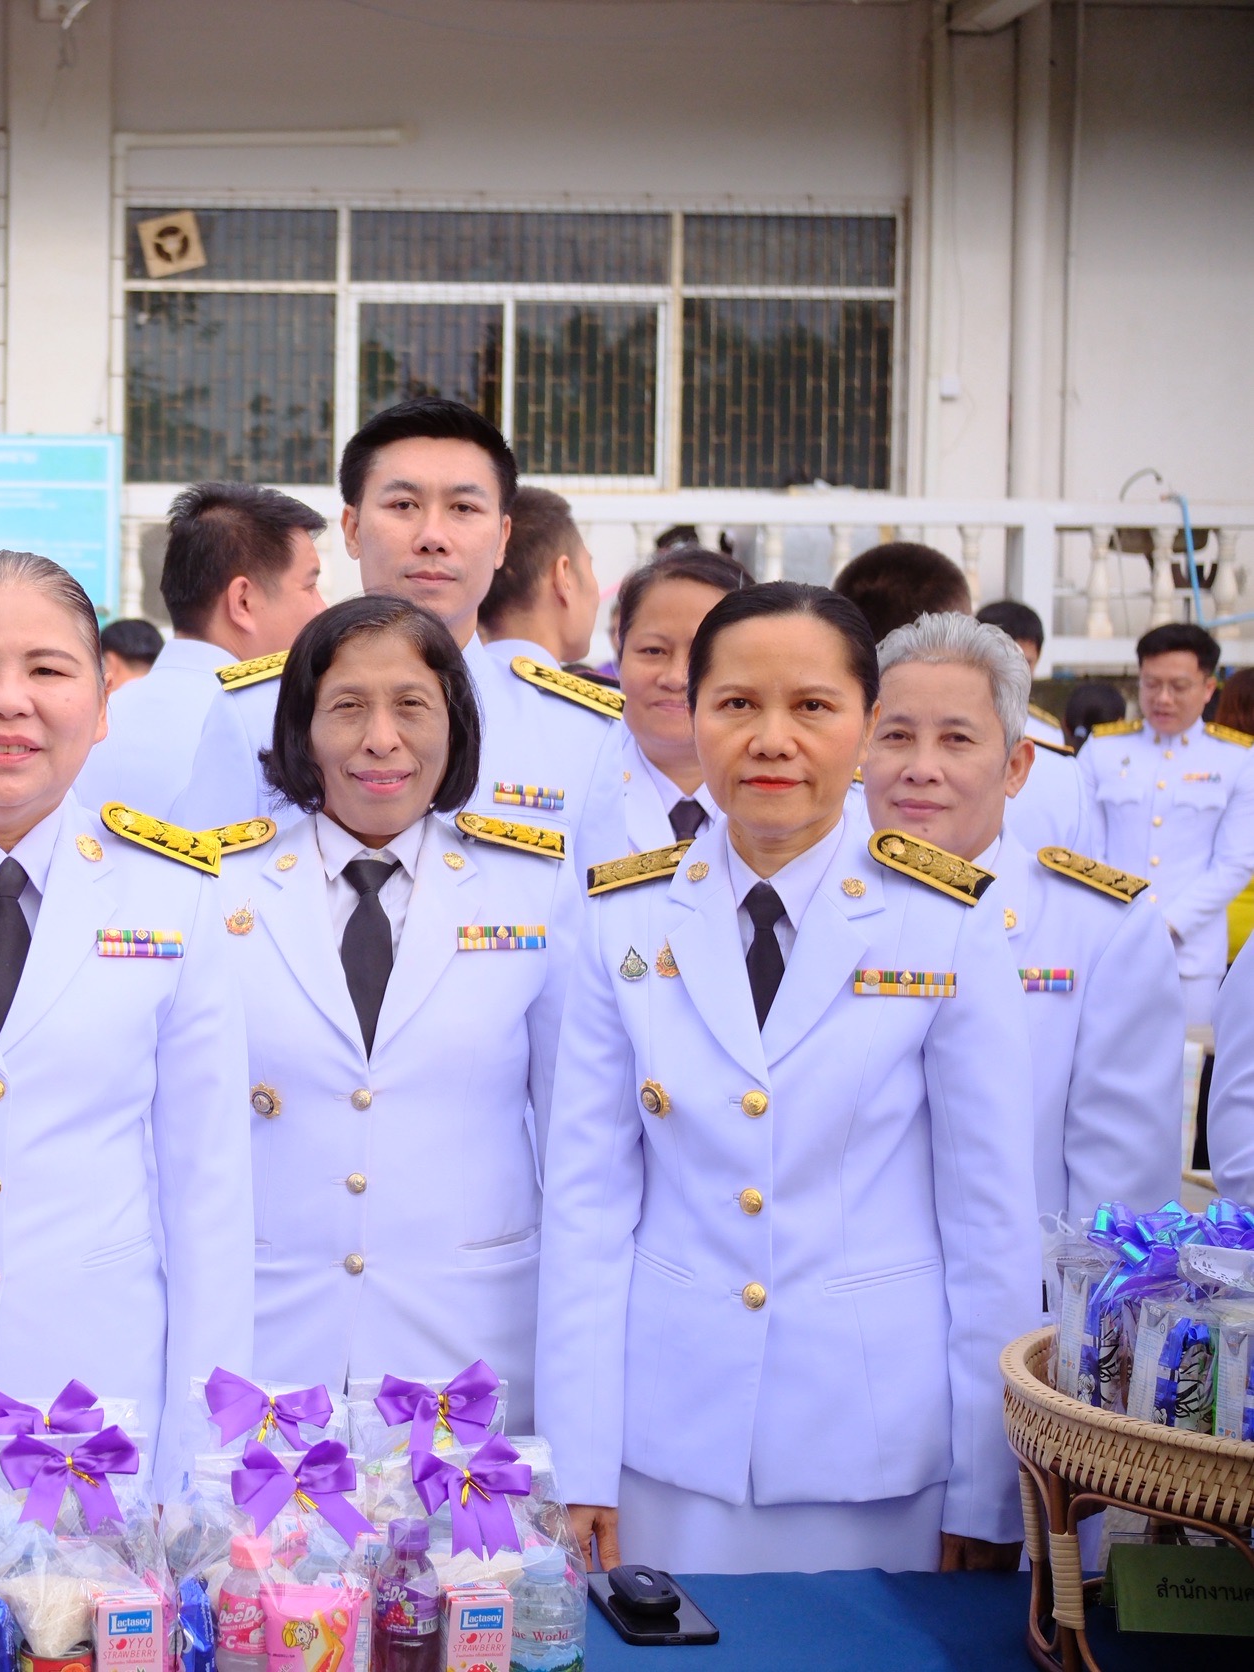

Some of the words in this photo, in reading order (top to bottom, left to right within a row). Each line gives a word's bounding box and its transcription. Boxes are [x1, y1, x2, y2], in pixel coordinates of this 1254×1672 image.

[219, 1605, 264, 1625] DeeDo
[462, 1610, 501, 1628] Lactasoy
[111, 1614, 151, 1633] Lactasoy
[532, 1629, 569, 1642] World
[103, 1649, 157, 1659] STRAWBERRY
[453, 1643, 506, 1653] STRAWBERRY
